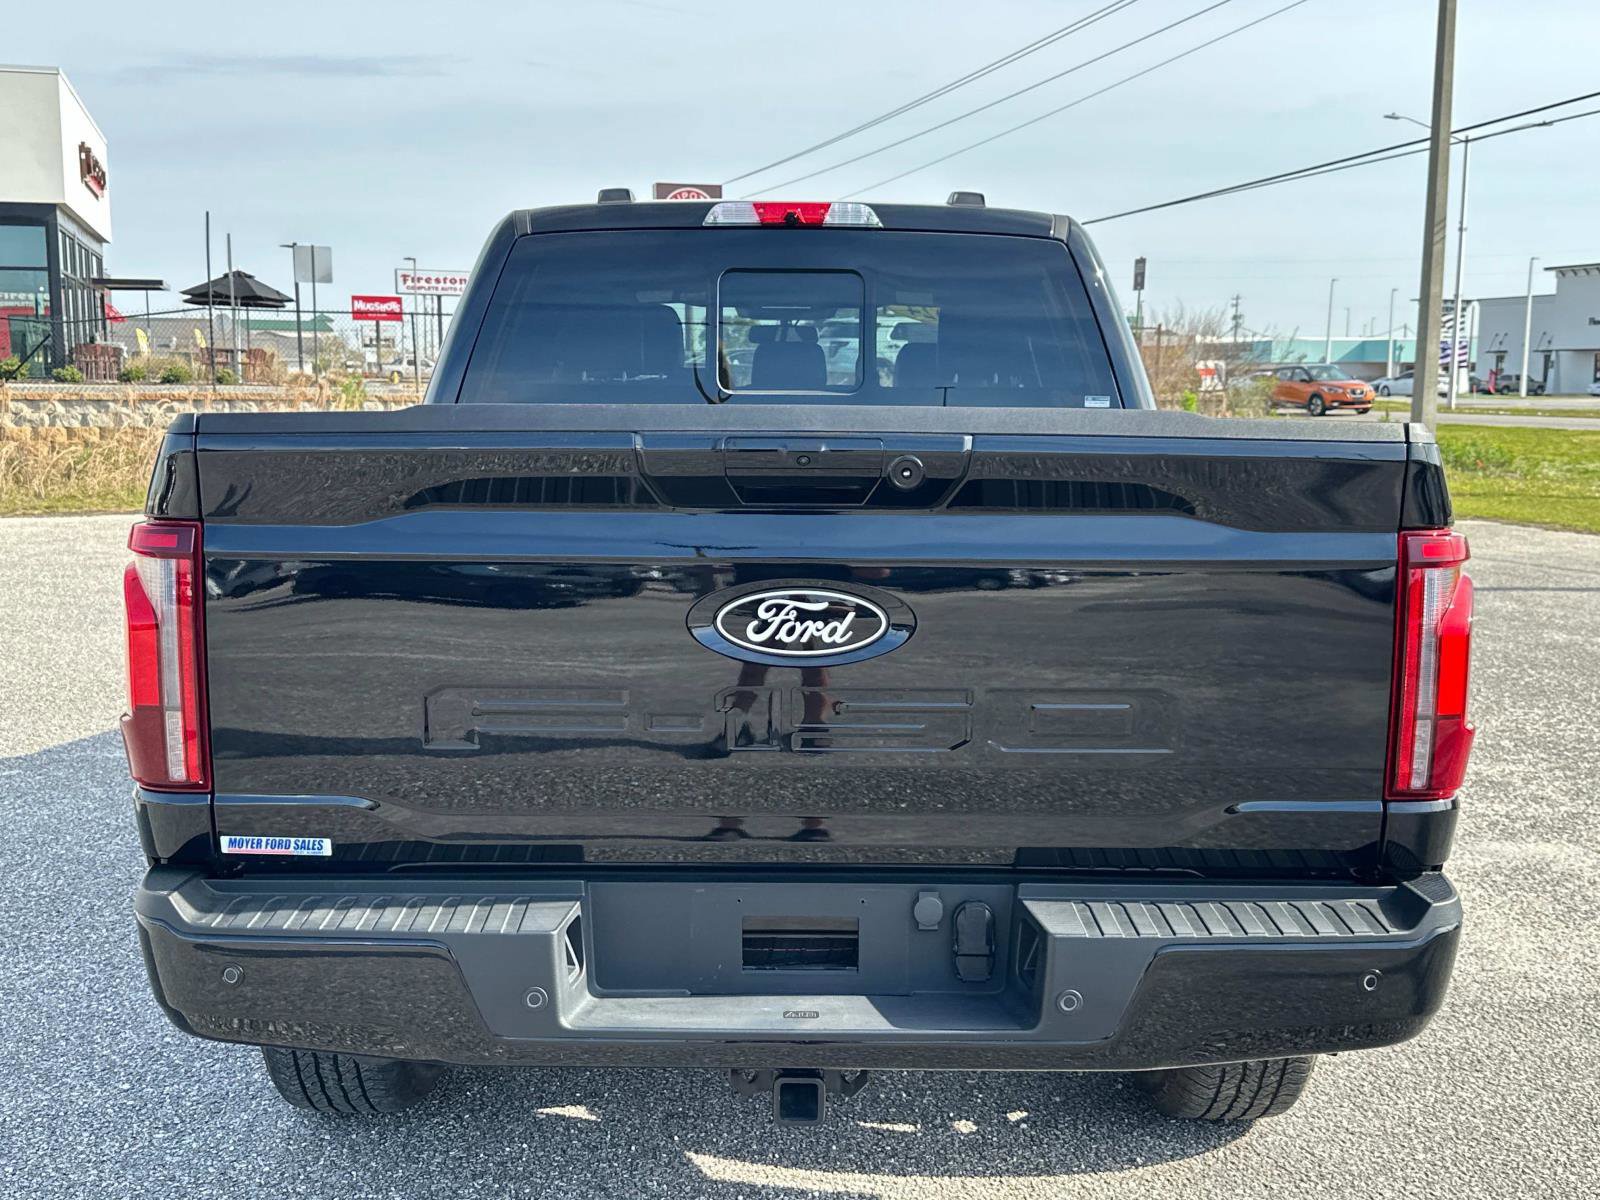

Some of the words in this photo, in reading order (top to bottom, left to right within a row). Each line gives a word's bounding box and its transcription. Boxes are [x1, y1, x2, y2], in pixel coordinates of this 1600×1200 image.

[401, 274, 467, 285] Fireston
[746, 599, 856, 643] Ford
[423, 685, 1178, 755] F-150
[228, 837, 262, 849] MOYER
[264, 838, 292, 850] FORD
[293, 838, 324, 850] SALES
